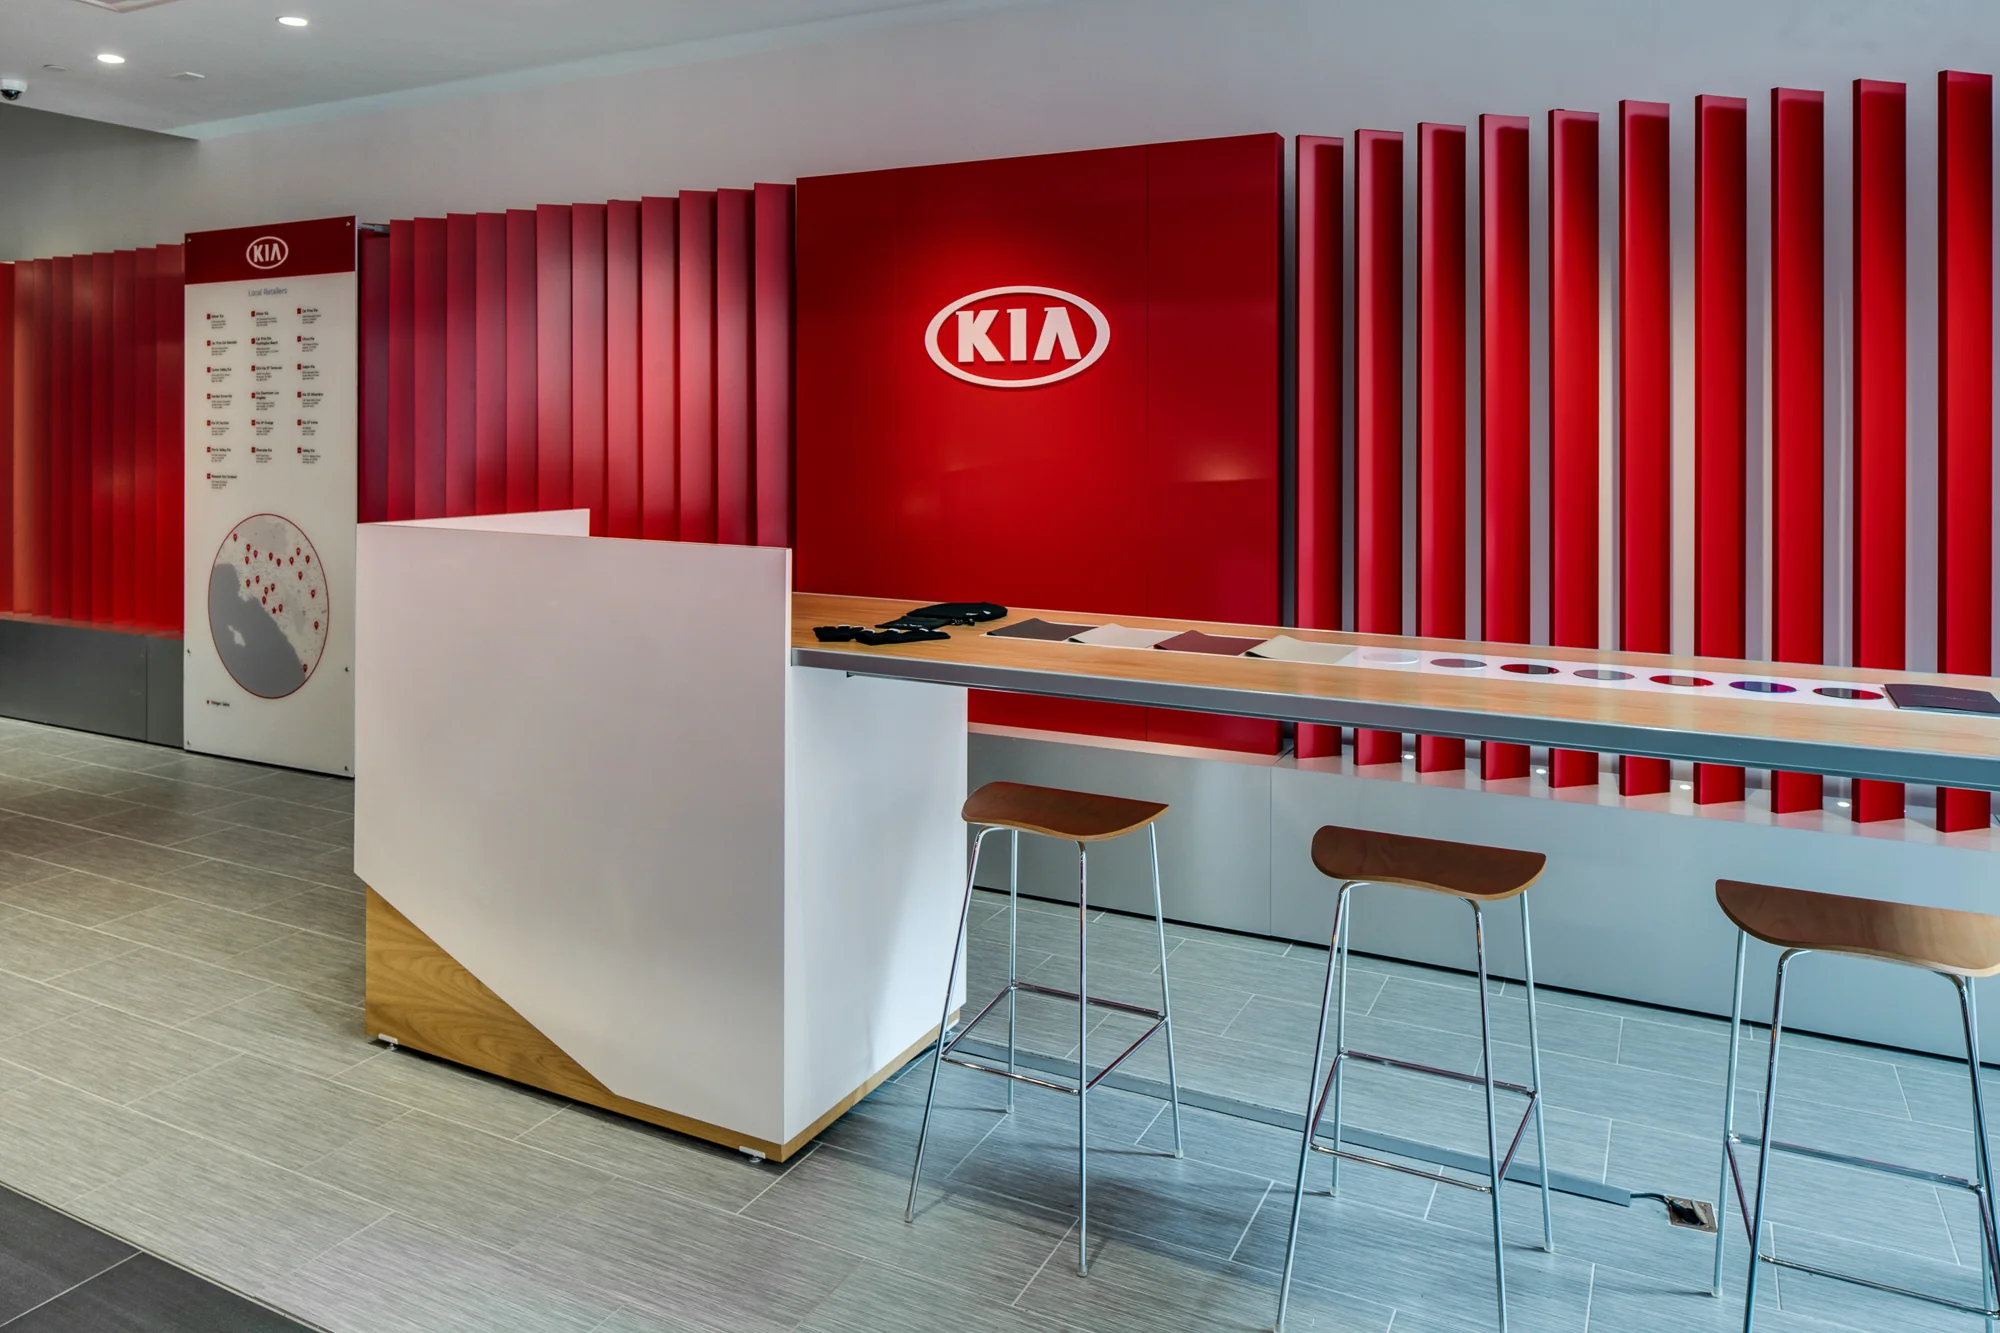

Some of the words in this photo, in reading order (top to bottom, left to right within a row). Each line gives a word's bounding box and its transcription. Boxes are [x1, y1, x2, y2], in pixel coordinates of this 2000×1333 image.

[253, 243, 281, 263] KIA
[248, 288, 262, 297] Local
[263, 286, 288, 296] Retailers
[956, 306, 1082, 363] KIA
